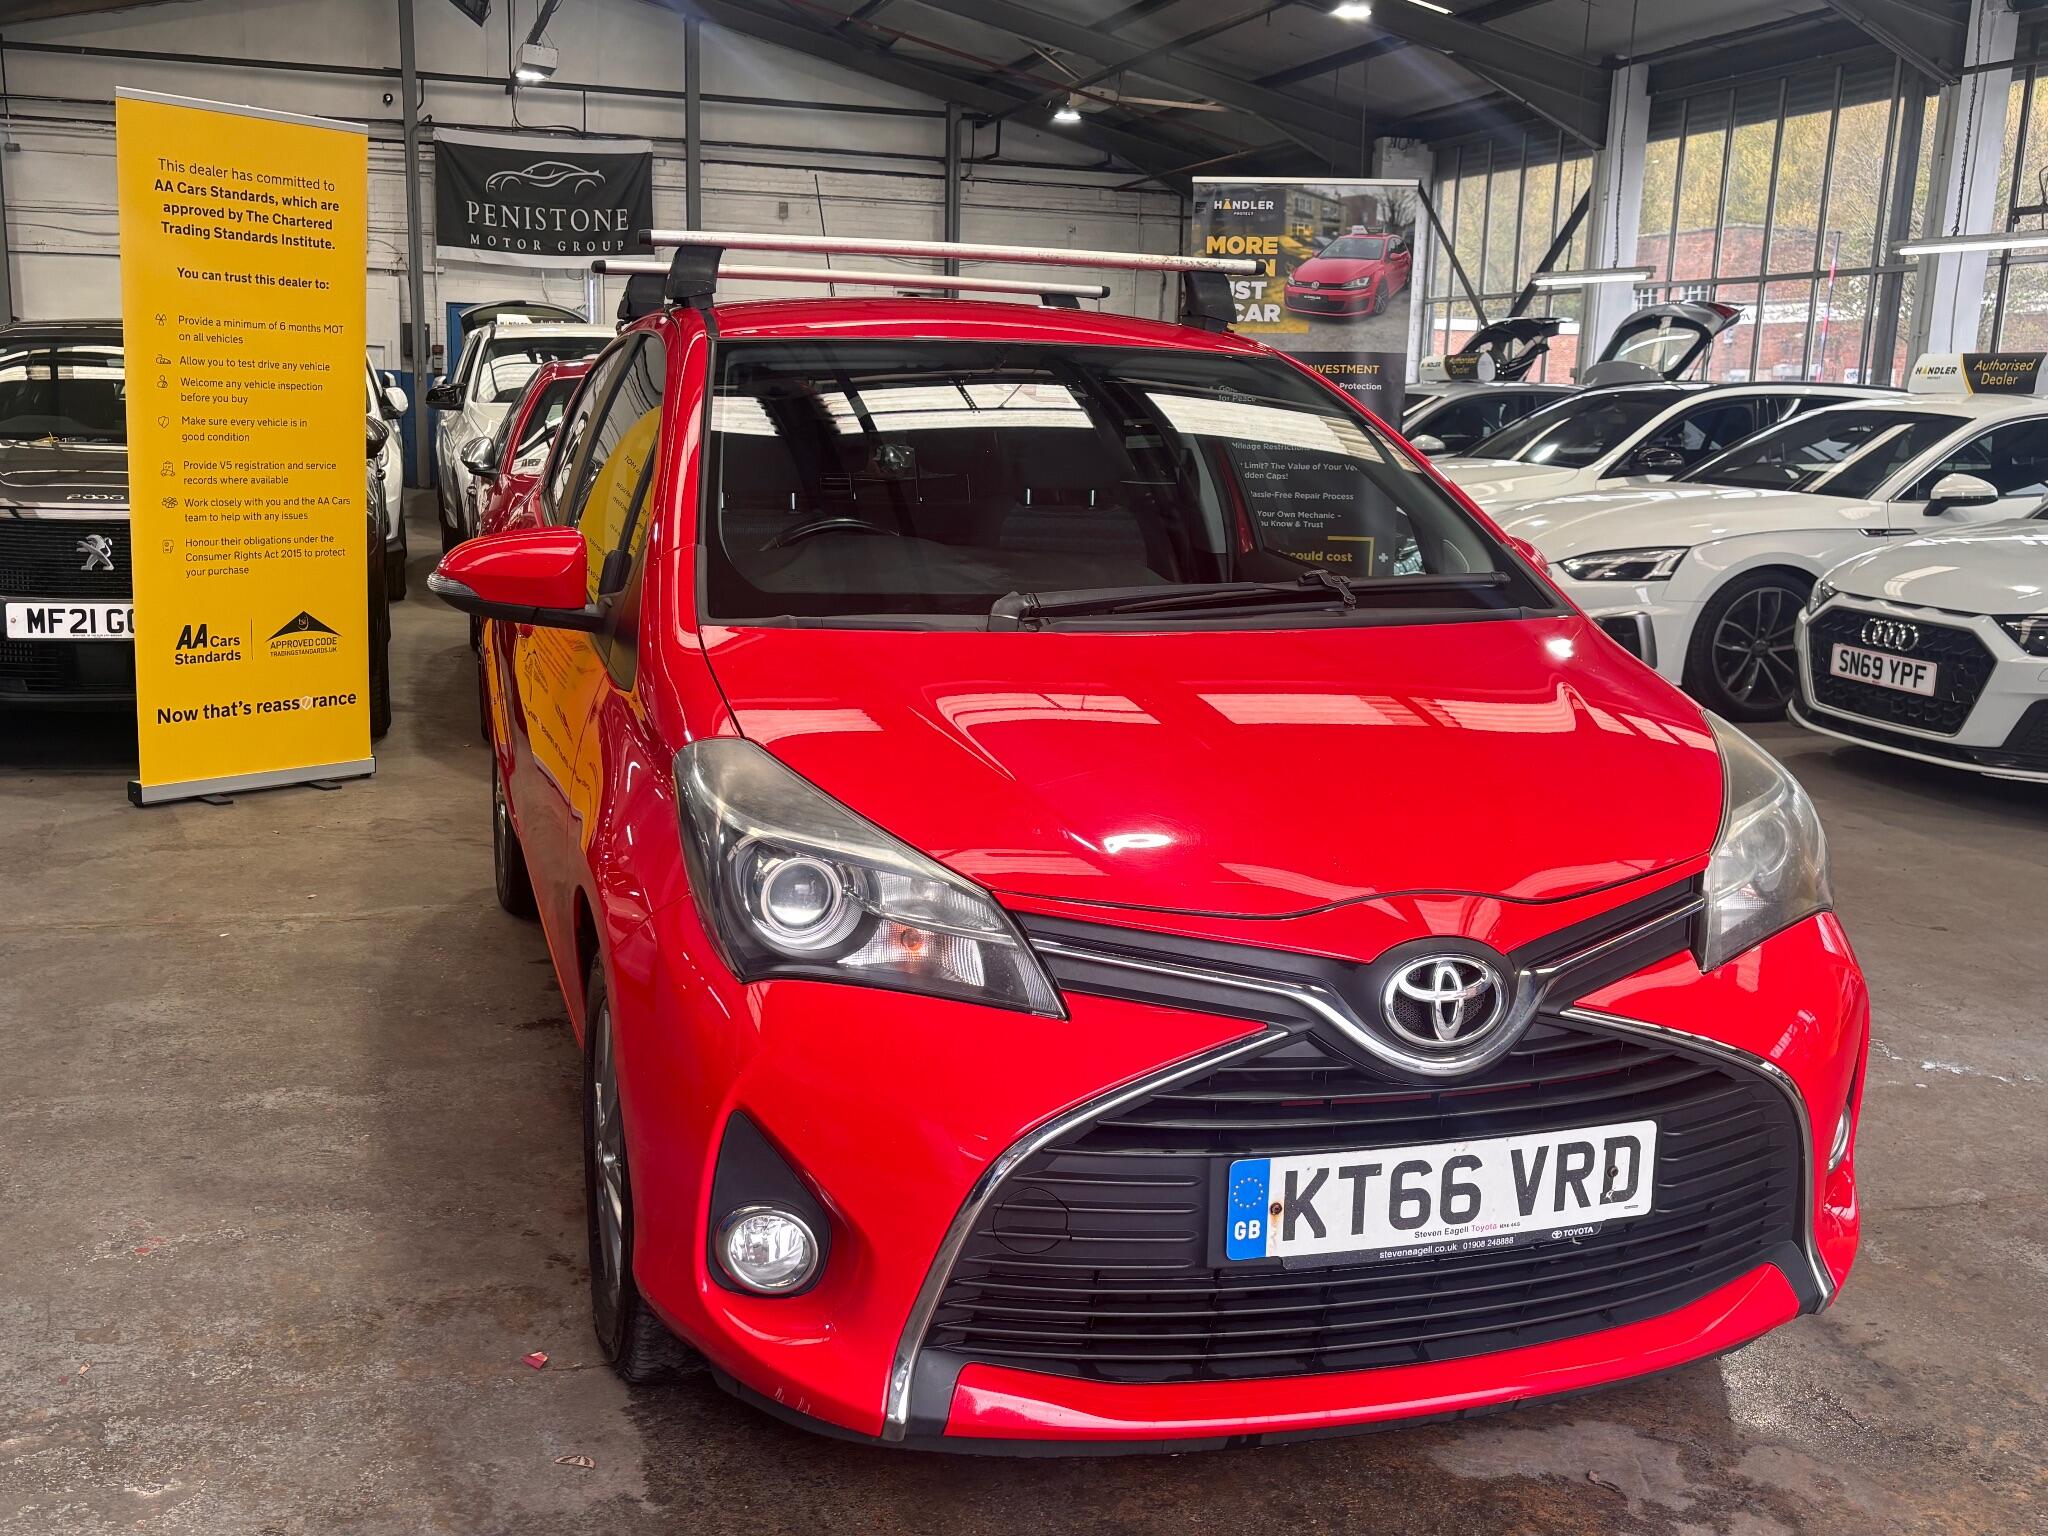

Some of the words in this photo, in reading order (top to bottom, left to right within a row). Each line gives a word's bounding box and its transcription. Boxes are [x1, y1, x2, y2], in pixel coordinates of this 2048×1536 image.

[158, 158, 186, 173] This
[190, 162, 228, 179] dealer
[232, 168, 253, 182] has
[256, 172, 320, 190] committed
[324, 180, 335, 192] to
[154, 179, 174, 192] AA
[177, 182, 207, 196] Cars
[210, 186, 279, 206] Standards,
[282, 196, 317, 210] which
[321, 201, 340, 212] are
[163, 203, 224, 219] approved
[228, 208, 243, 223] by
[246, 210, 269, 224] The
[272, 213, 333, 230] Chartered
[466, 200, 629, 232] PENISTONE
[161, 221, 210, 240] Trading
[214, 227, 278, 244] Standards
[282, 234, 336, 250] Institute.
[470, 234, 541, 251] MOTOR
[558, 240, 624, 251] GROUP
[1206, 236, 1279, 255] MORE
[177, 267, 198, 280] You
[202, 270, 222, 281] can
[225, 272, 252, 284] trust
[255, 274, 275, 286] this
[278, 277, 311, 289] dealer
[315, 280, 330, 290] to:
[178, 315, 213, 327] Provide
[216, 319, 221, 327] a
[224, 319, 266, 330] minimum
[268, 321, 278, 331] of
[280, 321, 286, 331] 6
[288, 322, 321, 333] months
[324, 324, 344, 334] MOT
[179, 332, 191, 342] on
[194, 332, 204, 342] all
[206, 334, 244, 344] vehicles
[180, 356, 205, 366] Allow
[208, 358, 224, 368] you
[226, 358, 236, 367] to
[238, 359, 255, 368] test
[258, 359, 280, 369] drive
[282, 362, 298, 372] any
[300, 361, 330, 371] vehicle
[1309, 364, 1380, 374] NVESTMENT
[1974, 359, 2037, 371] Authorised
[180, 378, 223, 388] Welcome
[226, 380, 242, 390] any
[244, 379, 275, 390] vehicle
[278, 382, 323, 392] inspection
[1980, 373, 2019, 386] Dealer
[1339, 383, 1382, 391] Protection
[180, 392, 210, 402] before
[212, 395, 228, 404] you
[231, 395, 248, 404] buy
[181, 416, 206, 426] Make
[209, 418, 228, 426] sure
[230, 419, 255, 428] every
[257, 418, 288, 427] vehicle
[290, 419, 298, 427] is
[300, 419, 307, 427] in
[181, 432, 205, 442] good
[207, 432, 250, 442] condition
[184, 461, 217, 470] Provide
[220, 461, 232, 470] V5
[234, 461, 285, 471] registration
[288, 461, 303, 470] and
[306, 461, 336, 470] service
[1244, 462, 1268, 470] Limit?
[1323, 463, 1342, 471] Your
[184, 476, 217, 485] records
[220, 475, 248, 484] where
[250, 475, 289, 484] available
[1266, 472, 1288, 481] Caps!
[184, 498, 208, 507] Work
[210, 498, 242, 508] closely
[244, 497, 263, 506] with
[265, 499, 281, 508] you
[283, 497, 299, 506] and
[301, 497, 315, 505] the
[317, 497, 330, 505] AA
[331, 496, 350, 505] Cars
[1250, 491, 1292, 499] assle-Free
[1294, 492, 1320, 500] Repair
[185, 514, 207, 522] team
[209, 513, 218, 521] to
[221, 512, 241, 522] help
[243, 512, 262, 521] with
[264, 513, 280, 522] any
[282, 512, 308, 520] issues
[1298, 511, 1336, 519] Mechanic
[186, 538, 218, 547] Honour
[220, 537, 241, 546] their
[244, 536, 291, 547] obligations
[294, 535, 318, 544] under
[320, 535, 334, 543] the
[186, 552, 231, 562] Consumer
[234, 551, 262, 561] Rights
[264, 550, 278, 559] Act
[281, 550, 302, 558] 2015
[304, 549, 313, 558] to
[315, 548, 345, 559] protect
[1327, 552, 1352, 562] cost
[186, 568, 205, 578] your
[208, 566, 249, 576] purchase
[27, 608, 96, 634] MF21
[175, 624, 207, 650] AA
[210, 636, 240, 648] Cars
[270, 638, 313, 649] APPROVED
[316, 637, 338, 646] CODE
[175, 650, 241, 665] Standards
[1839, 650, 1883, 680] SN69
[1890, 659, 1927, 688] YPF
[157, 707, 198, 724] Now
[203, 700, 252, 720] that's
[1282, 1154, 1482, 1242] KT66
[1510, 1135, 1641, 1217] VRD
[1234, 1220, 1260, 1241] GB
[1414, 1228, 1442, 1238] Steven
[1444, 1226, 1469, 1236] Eagell
[1472, 1223, 1498, 1233] Toyota
[1563, 1226, 1594, 1237] TOYOTA
[1380, 1243, 1457, 1258] steveneagell.co.uk
[1463, 1241, 1485, 1250] 01908
